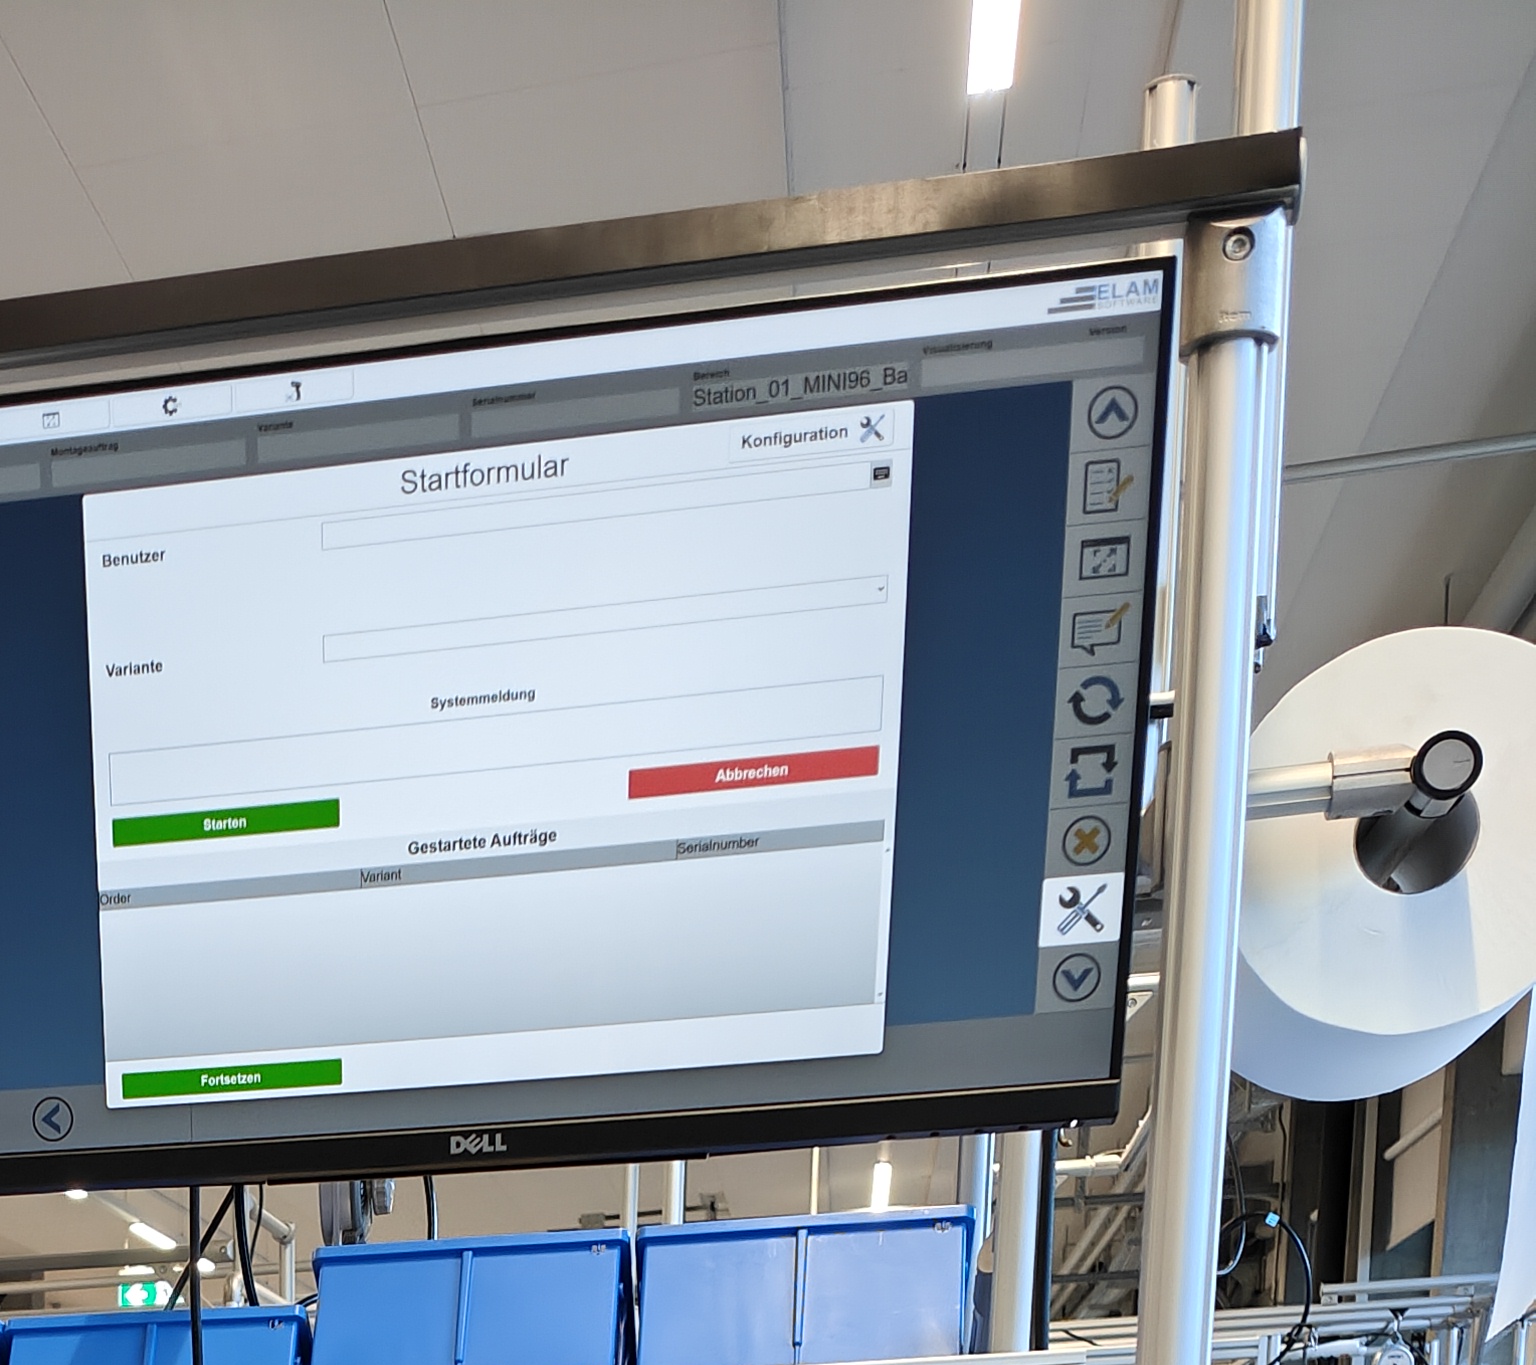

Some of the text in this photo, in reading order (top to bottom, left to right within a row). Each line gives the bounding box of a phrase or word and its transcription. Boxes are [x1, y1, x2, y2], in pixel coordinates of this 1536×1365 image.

[1098, 279, 1159, 300] ELAM
[693, 367, 908, 407] Station_01_MINI96_Ba
[741, 423, 849, 450] Konfiguration
[400, 454, 569, 495] Startformular
[102, 548, 165, 568] Benutzer
[105, 658, 163, 677] Variante
[430, 687, 536, 711] Systemmeldung
[715, 762, 789, 783] Abbrechen
[202, 815, 247, 831] Starten
[407, 827, 557, 856] Gestartete Aufträge
[677, 834, 760, 856] Serialnumber
[362, 868, 402, 884] Variant
[100, 892, 131, 906] Order
[200, 1071, 261, 1087] Fortsetzen
[450, 1133, 507, 1155] DELL
